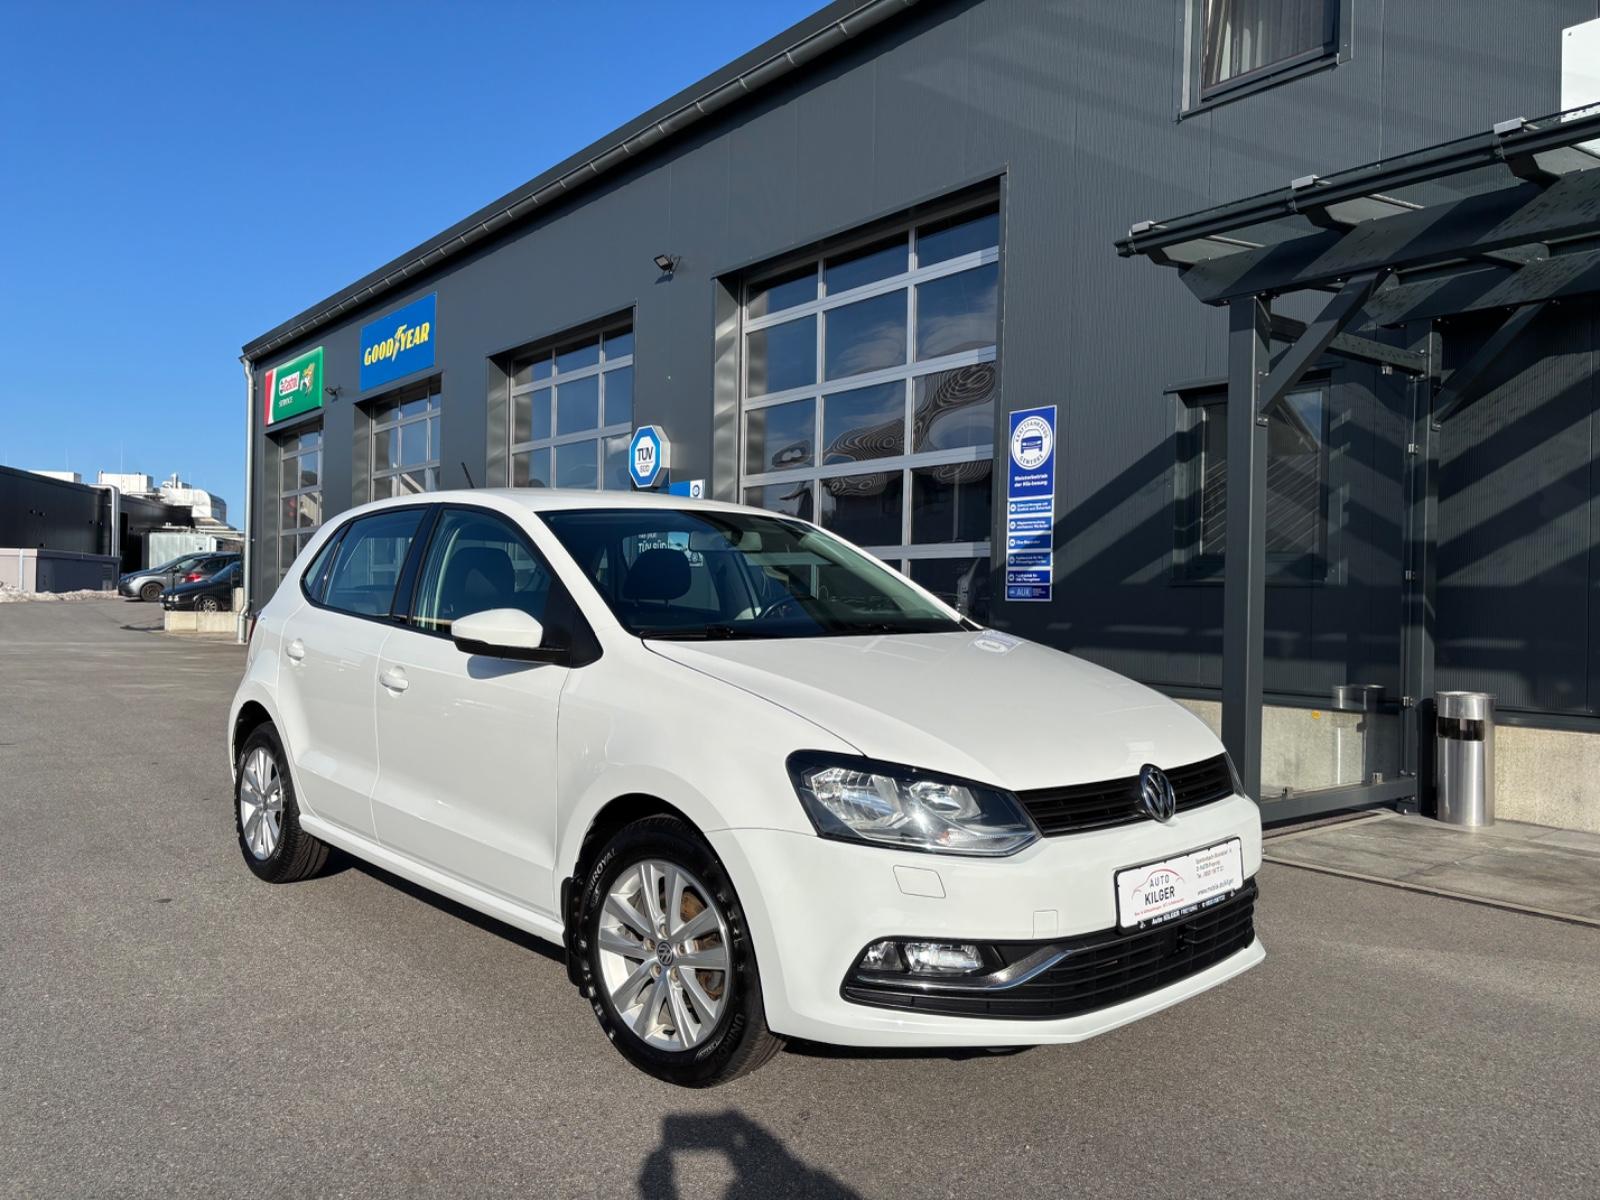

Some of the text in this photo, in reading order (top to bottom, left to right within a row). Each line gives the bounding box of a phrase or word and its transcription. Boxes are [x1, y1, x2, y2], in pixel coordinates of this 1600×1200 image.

[363, 322, 430, 366] GOODYEAR
[637, 446, 654, 462] TÜV
[1149, 874, 1170, 888] AUTO
[1144, 885, 1176, 906] KILGER
